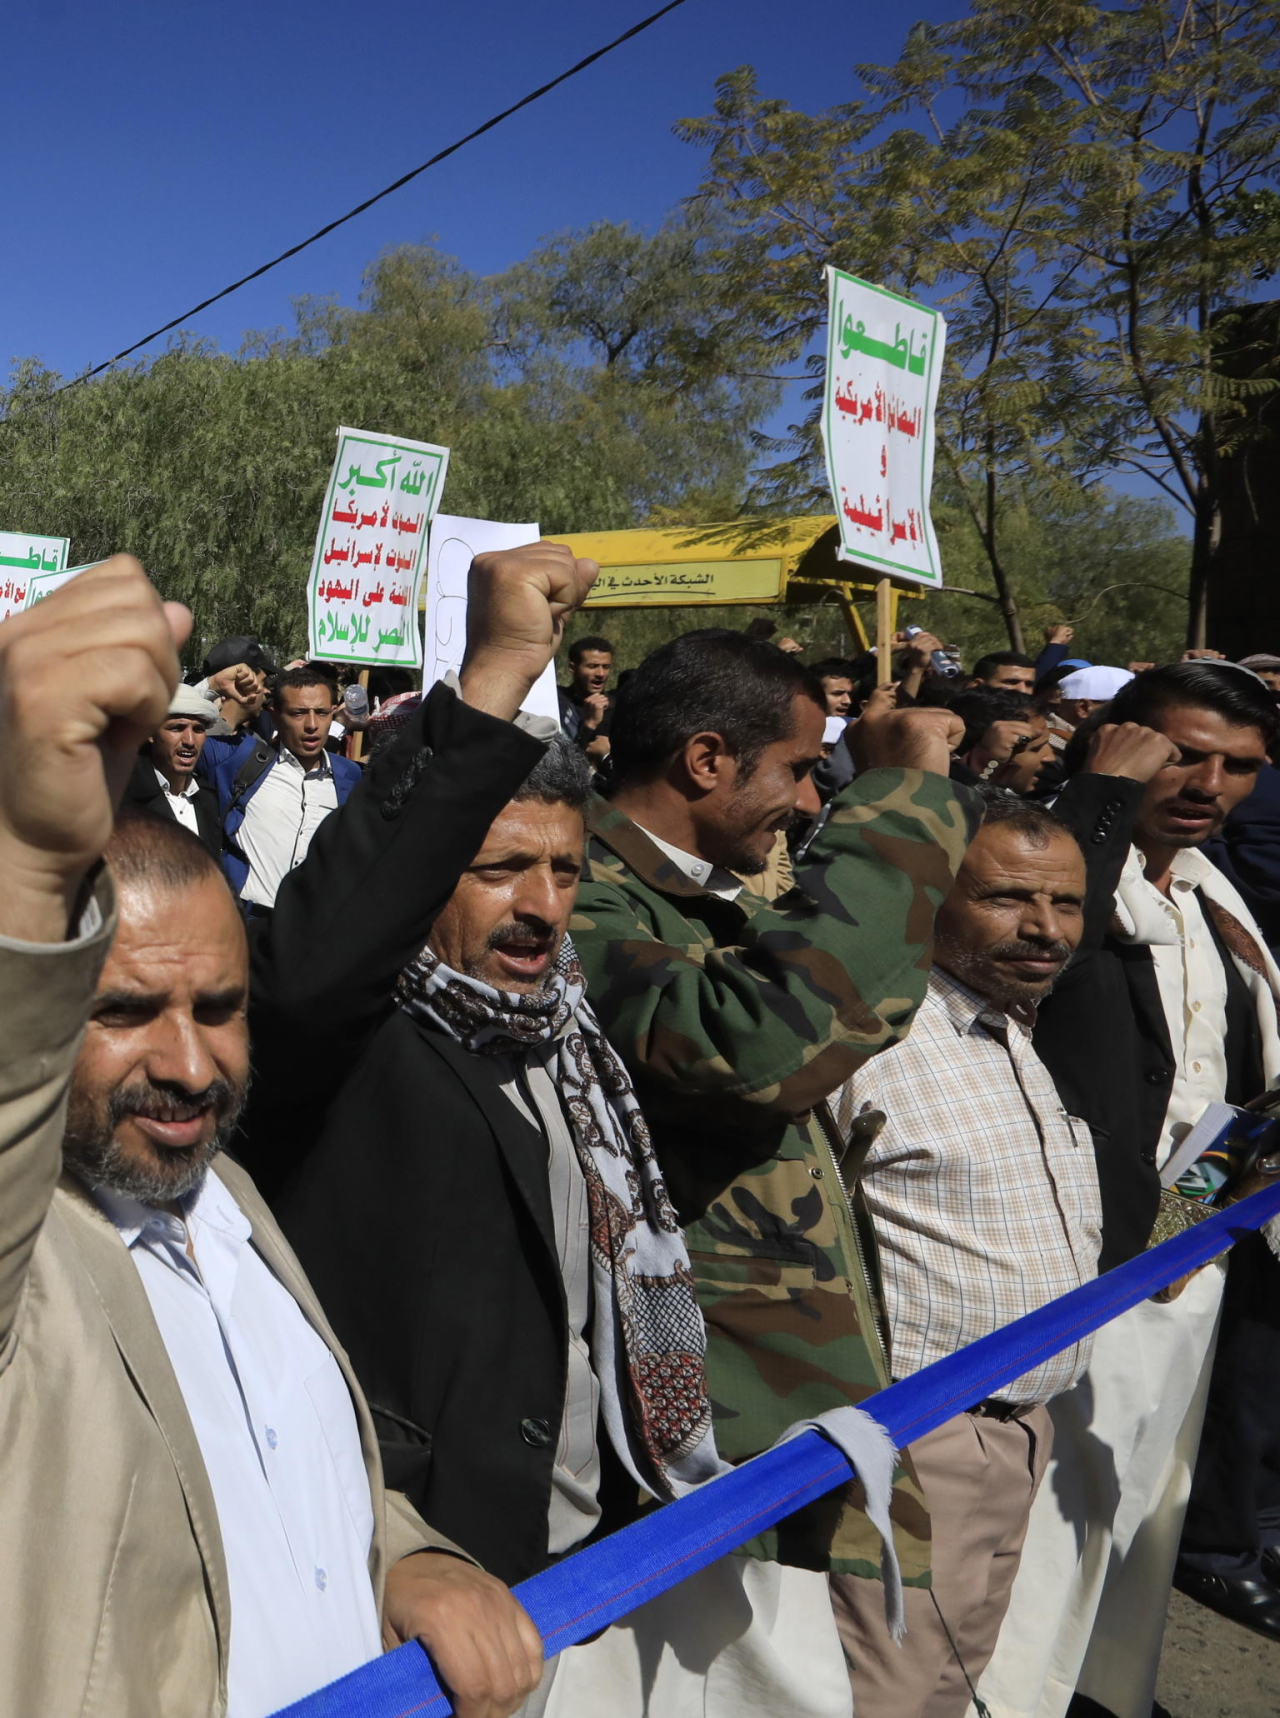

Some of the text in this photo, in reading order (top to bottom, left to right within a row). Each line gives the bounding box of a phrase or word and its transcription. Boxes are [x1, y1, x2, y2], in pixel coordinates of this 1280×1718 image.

[836, 298, 928, 377] قاطعوا
[337, 449, 435, 498] الله أكبر
[879, 444, 888, 478] و
[331, 497, 425, 537] الموت لأمريكا
[323, 536, 418, 574] الوت لإسرائيل
[317, 577, 361, 605] اليهود
[362, 580, 385, 608] على
[589, 572, 715, 591] الشبكة الأحدث في الي
[317, 609, 411, 655] الصر للإسلام
